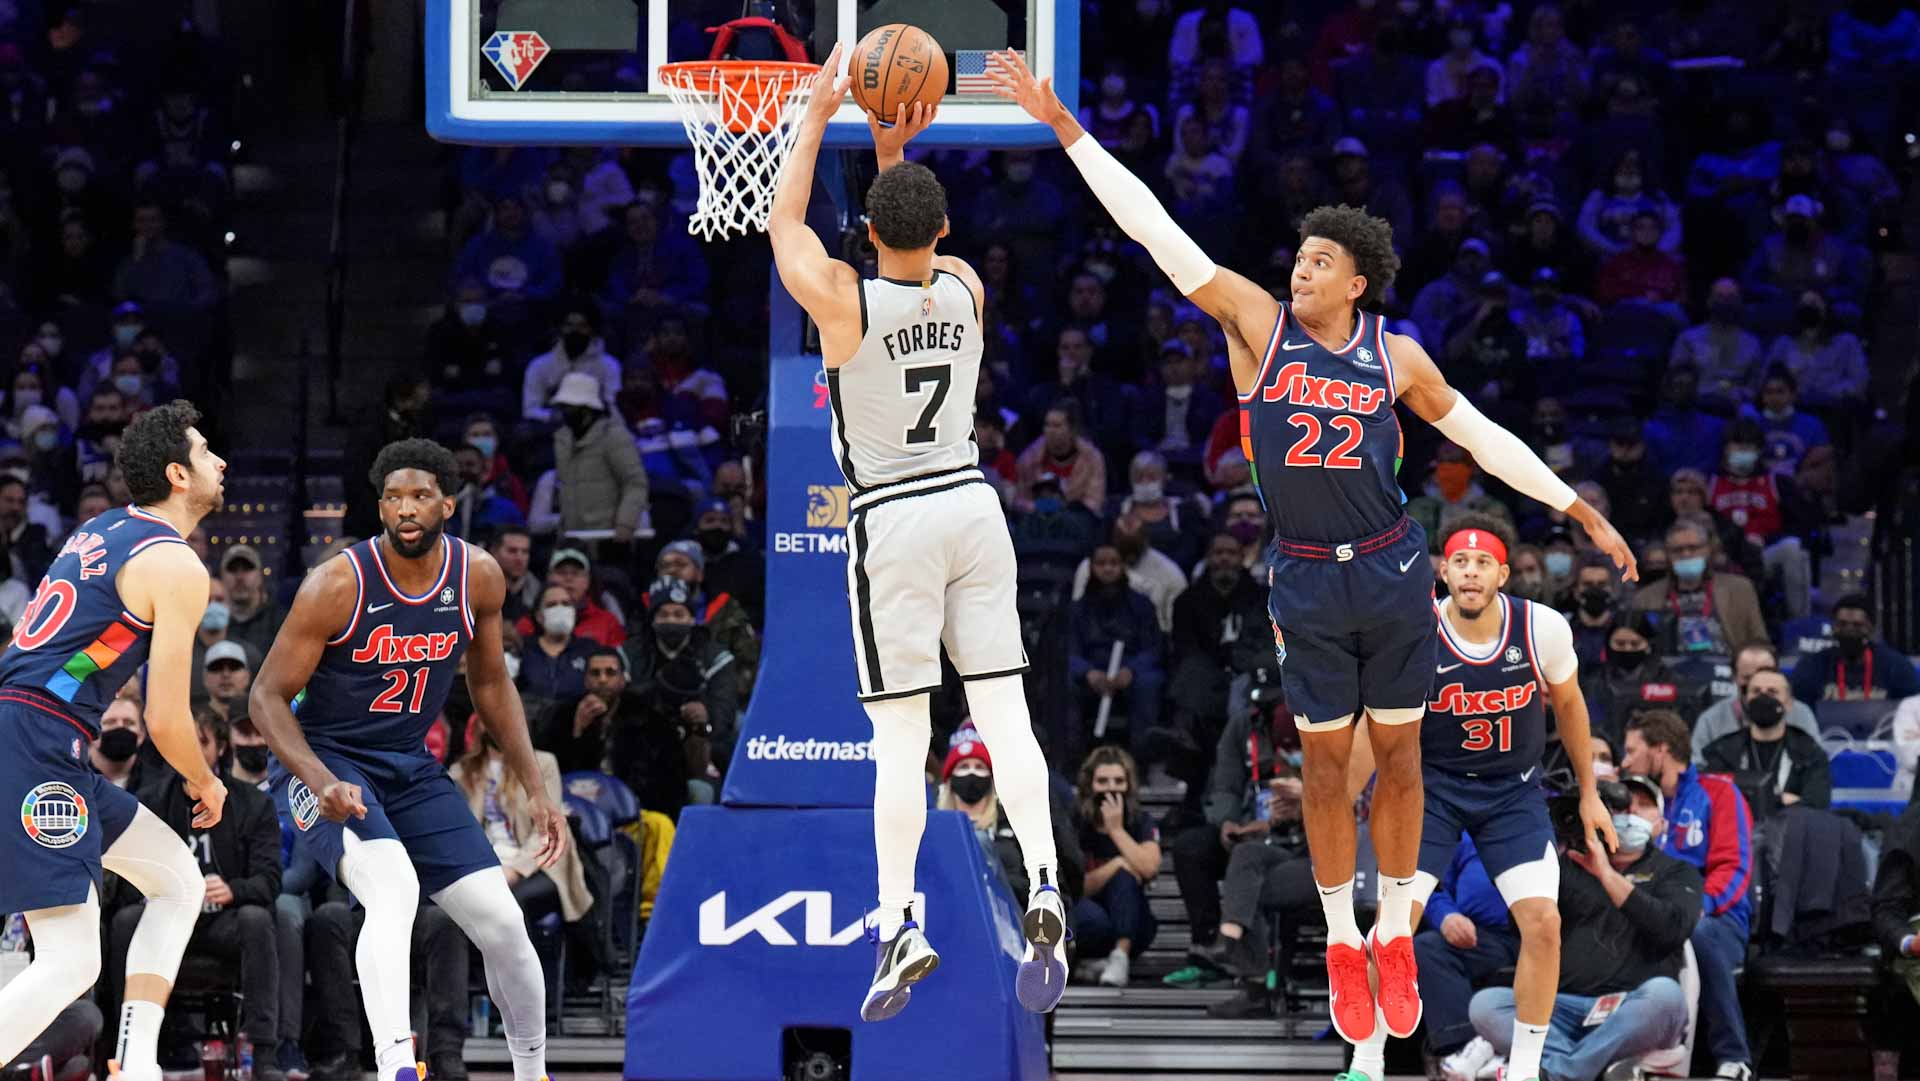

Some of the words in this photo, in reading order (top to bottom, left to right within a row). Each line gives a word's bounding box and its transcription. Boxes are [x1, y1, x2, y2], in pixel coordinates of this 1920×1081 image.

[864, 29, 897, 89] Wilson
[883, 322, 964, 361] FORBES
[902, 360, 954, 447] 7
[1263, 361, 1386, 415] Sixers
[1284, 412, 1364, 470] 22
[774, 532, 848, 554] BETM
[352, 624, 459, 665] Sixers
[369, 666, 431, 714] 21
[1428, 680, 1537, 717] Sixers
[746, 734, 876, 761] ticketmast
[1461, 715, 1512, 753] 31
